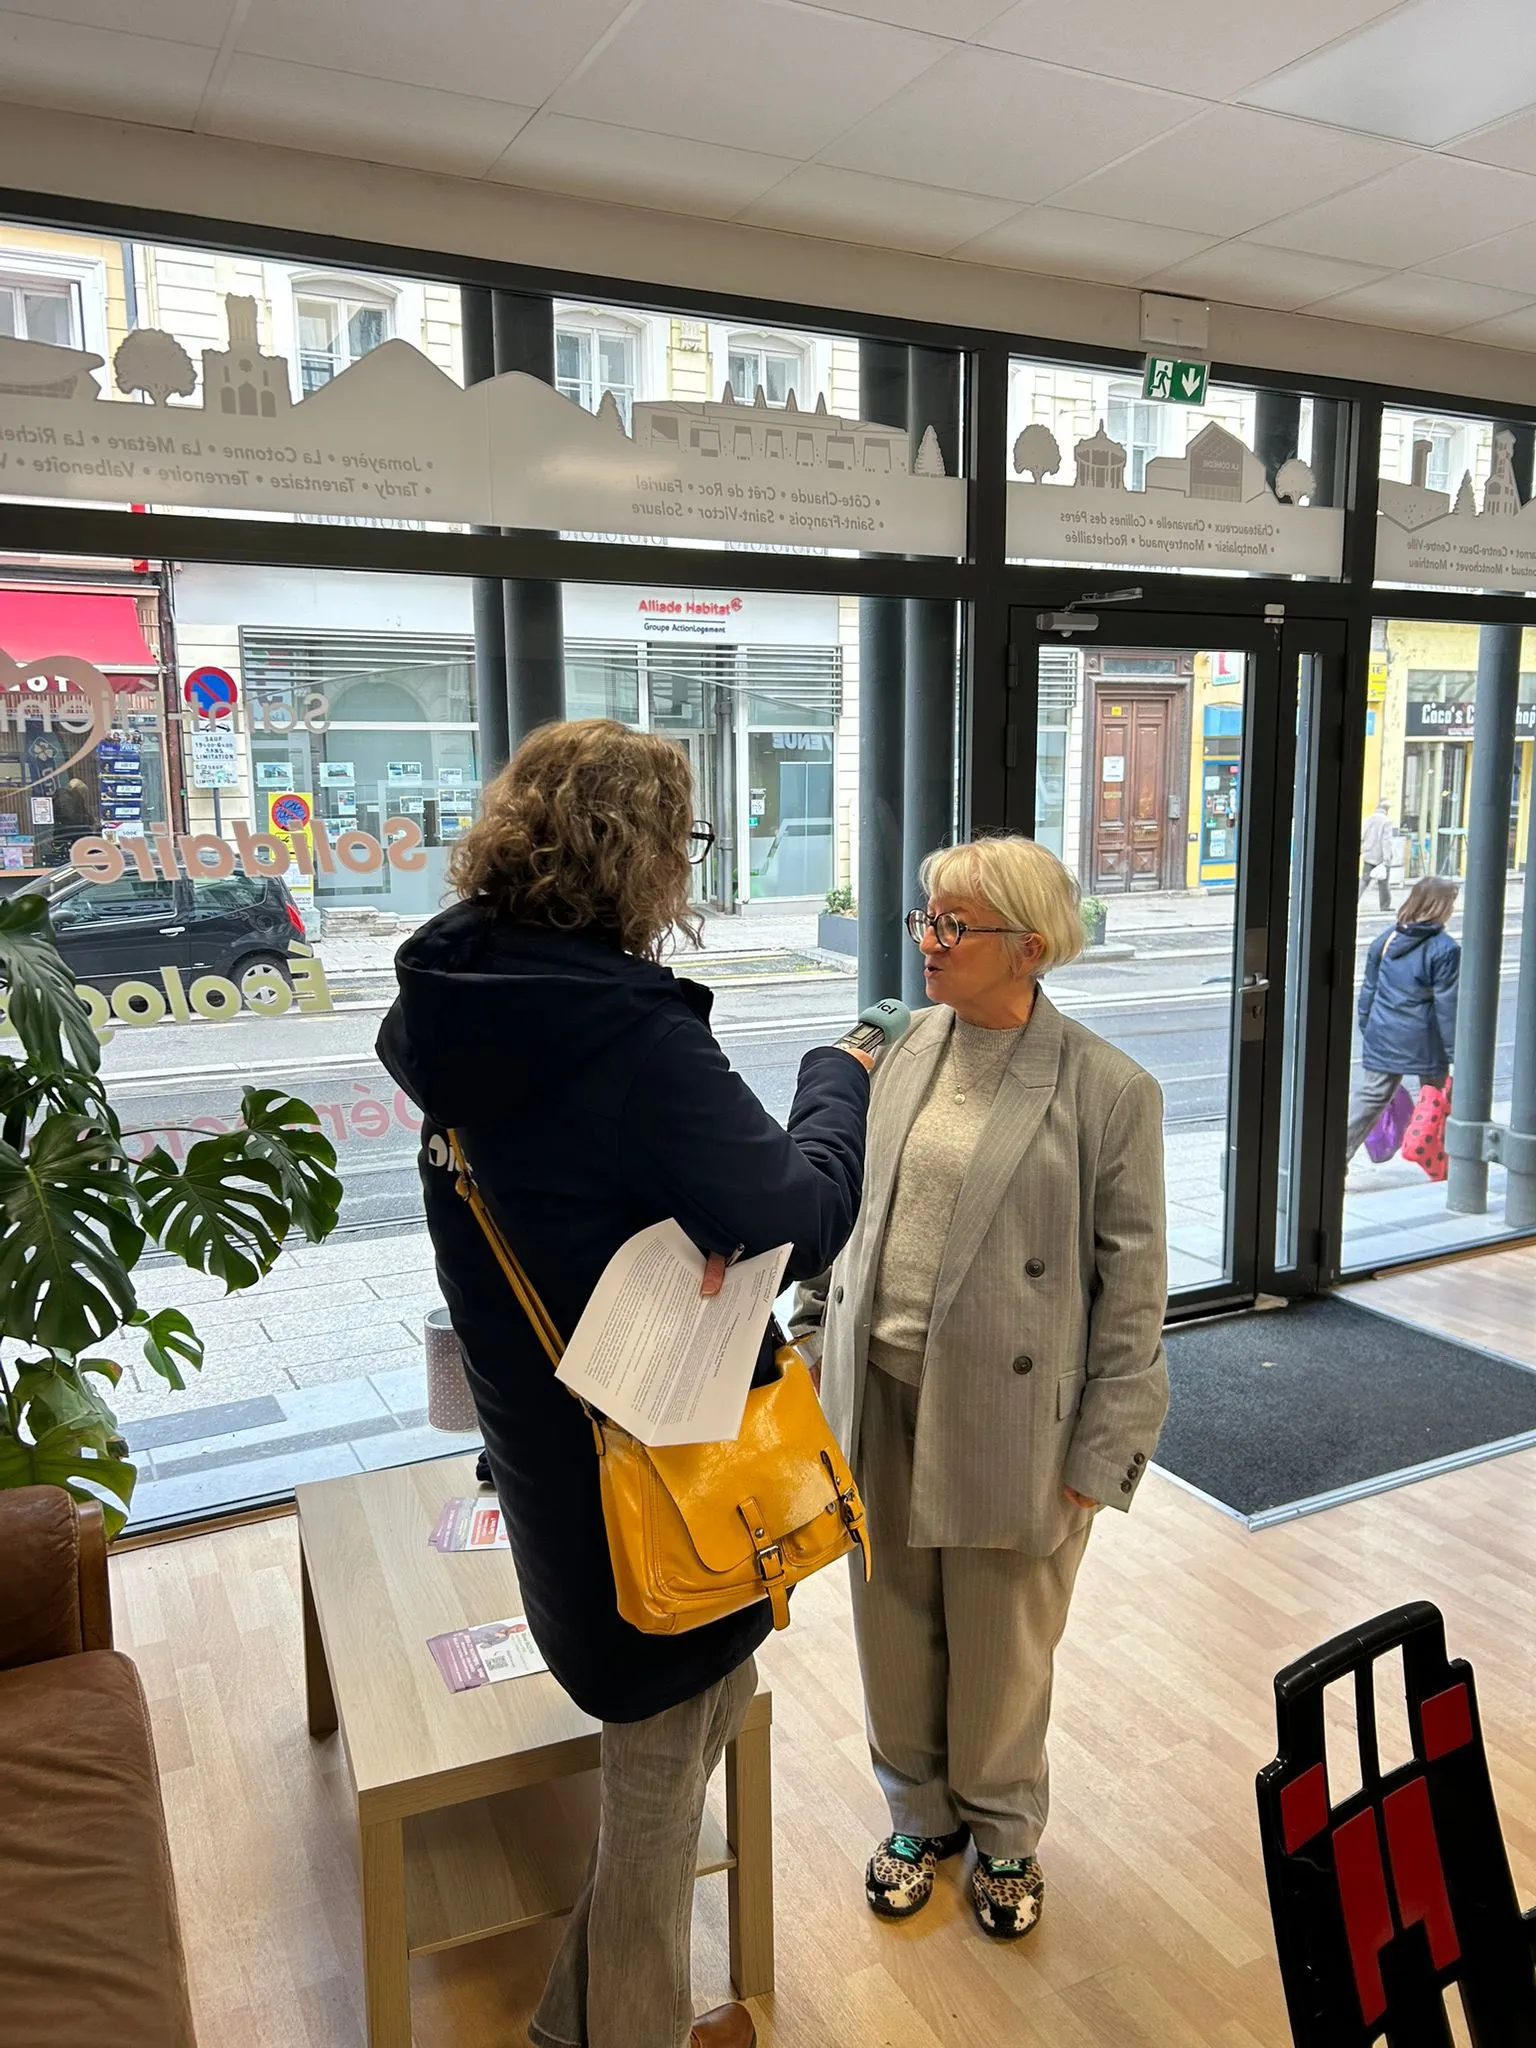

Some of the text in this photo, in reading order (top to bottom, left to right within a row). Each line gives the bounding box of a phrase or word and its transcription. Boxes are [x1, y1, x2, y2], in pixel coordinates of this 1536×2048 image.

[639, 599, 730, 615] Alliade Habitat
[644, 622, 670, 633] Groupe
